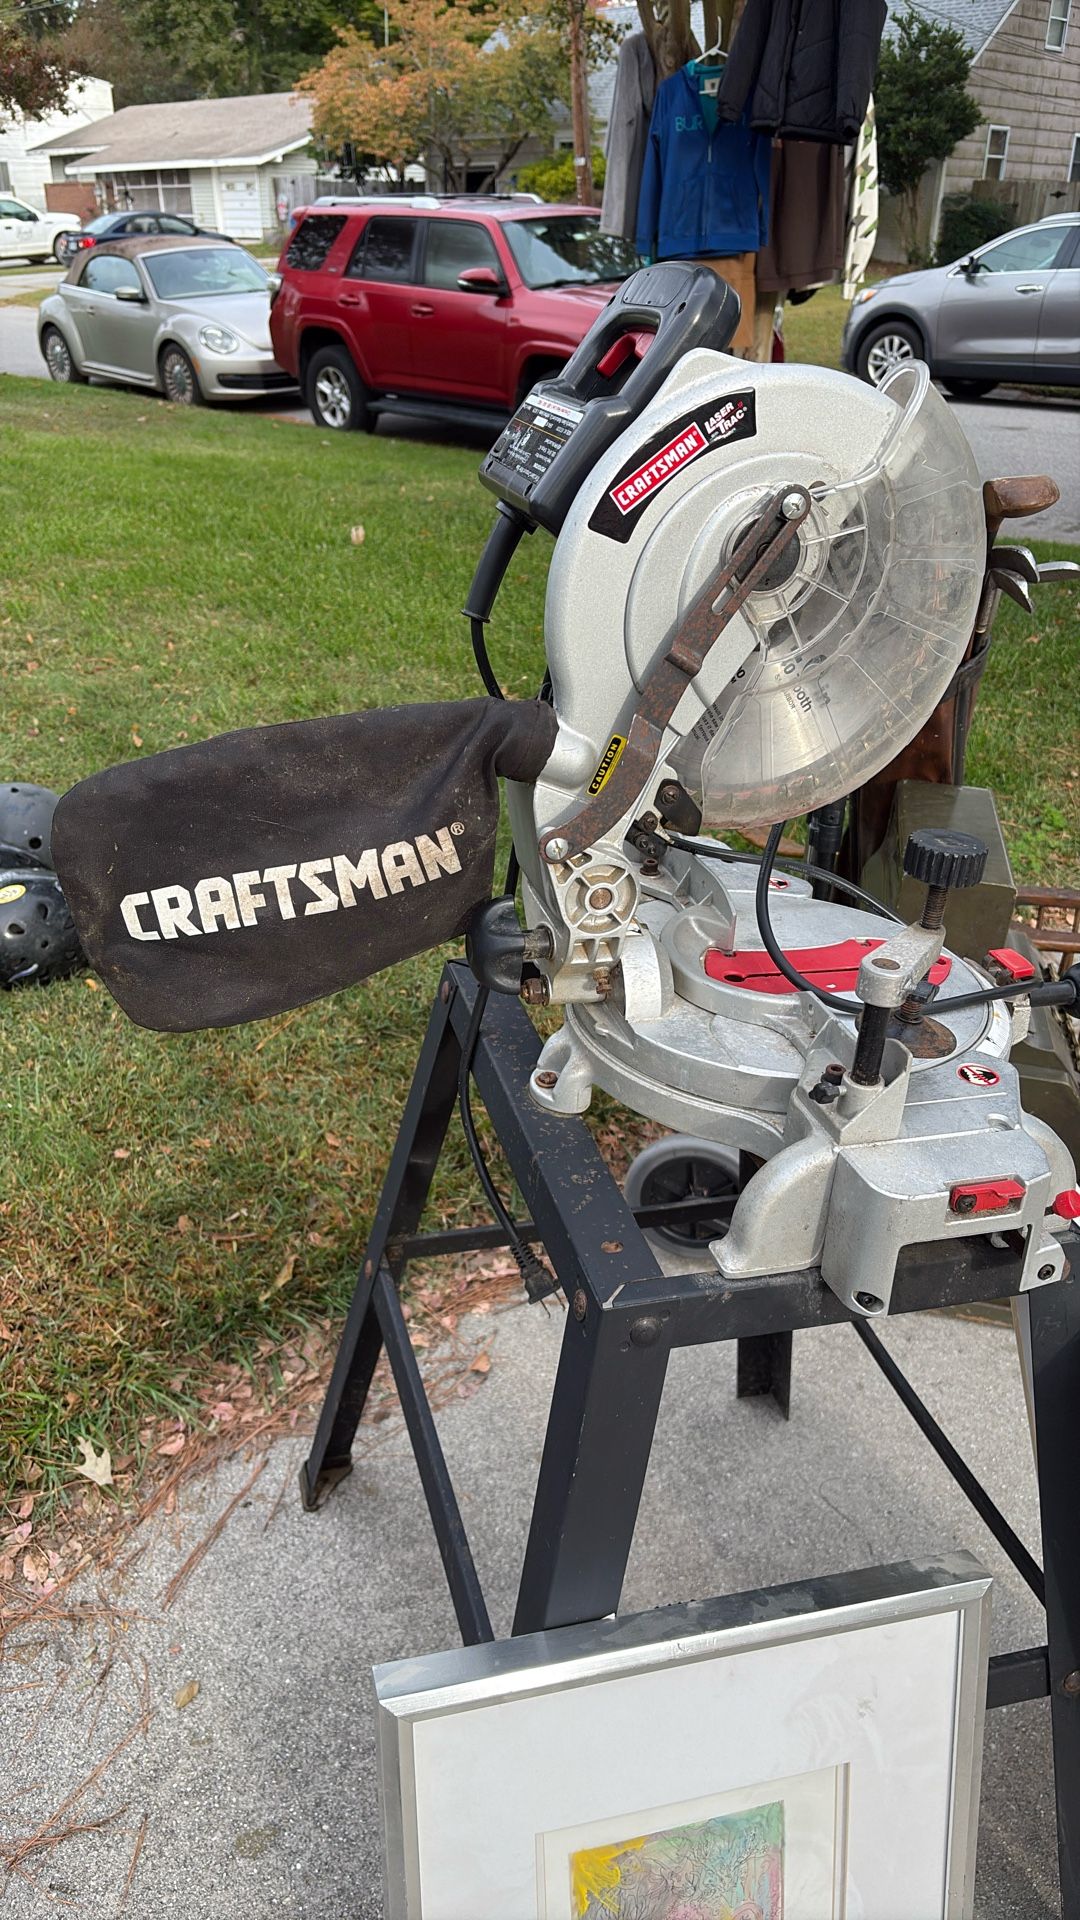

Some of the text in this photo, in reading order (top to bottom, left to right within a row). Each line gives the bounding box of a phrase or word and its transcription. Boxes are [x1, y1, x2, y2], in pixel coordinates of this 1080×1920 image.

[704, 401, 735, 434] LASER
[716, 409, 745, 434] TRAC
[617, 433, 698, 506] CRAFTSMAN
[591, 742, 618, 790] CAUTION
